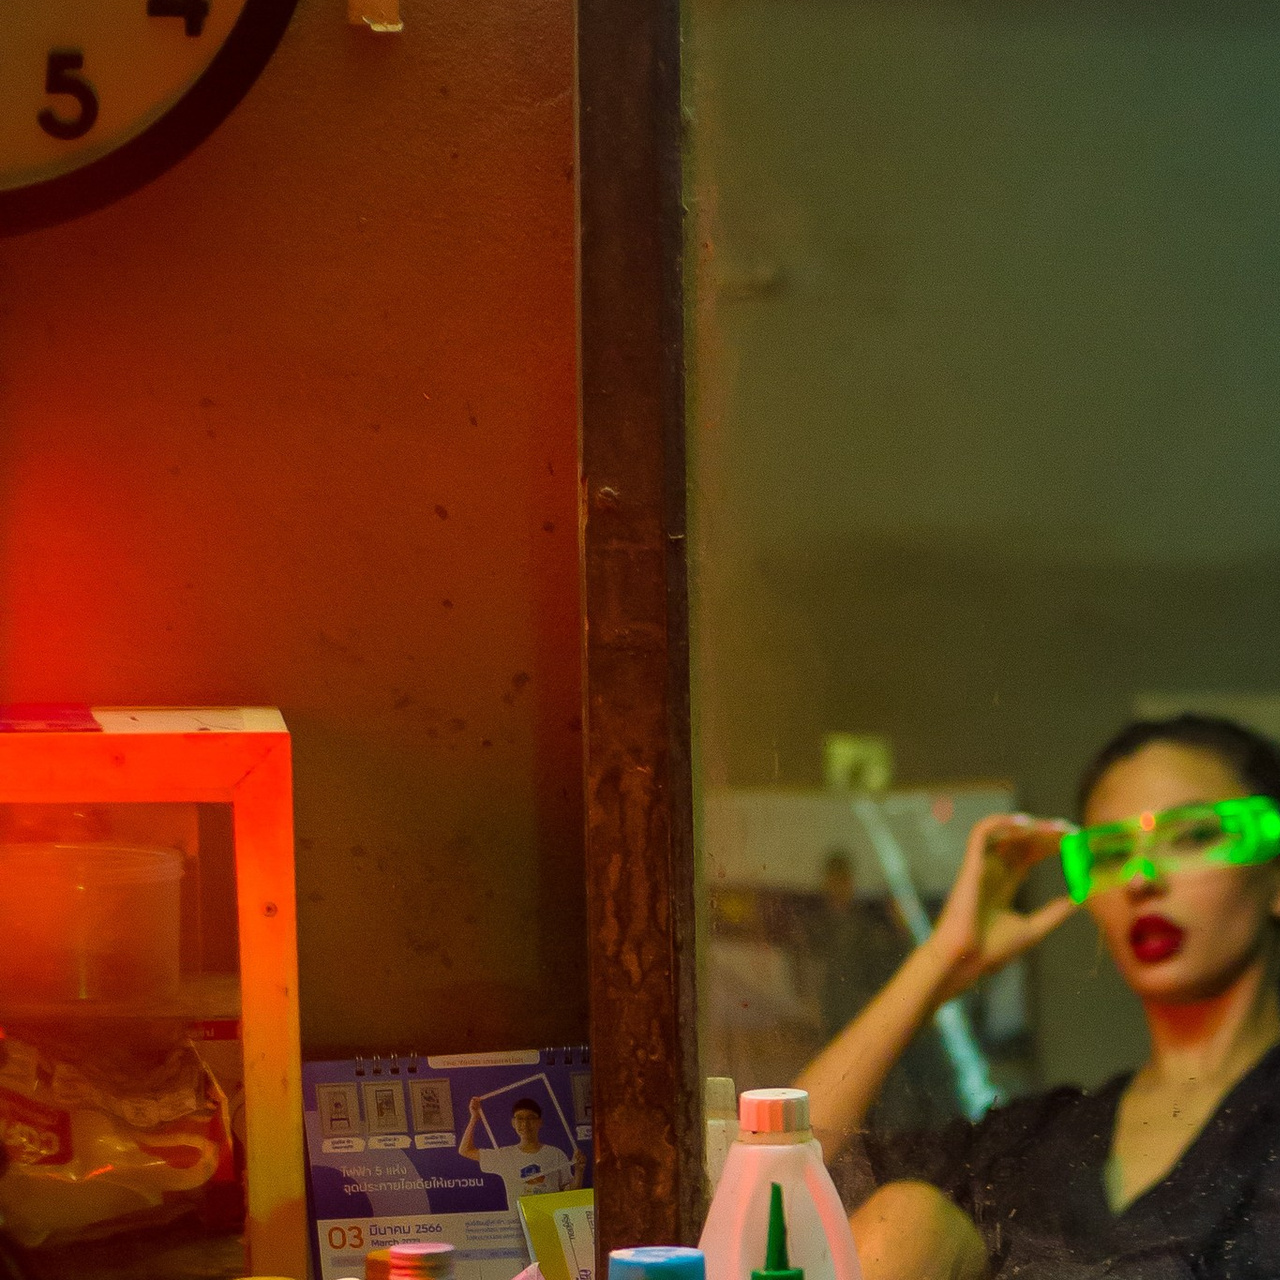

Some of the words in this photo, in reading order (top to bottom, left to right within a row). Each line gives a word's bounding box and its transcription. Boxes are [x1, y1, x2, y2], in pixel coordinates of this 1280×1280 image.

[37, 48, 98, 140] 5
[375, 1166, 382, 1176] 5
[386, 1164, 408, 1176] แห่ง
[343, 1176, 484, 1195] จุดประกายไอเดียให้เยาวชน
[328, 1226, 364, 1249] 03
[369, 1224, 411, 1236] มีนาคม
[415, 1223, 442, 1234] 2566
[371, 1237, 399, 1247] March
